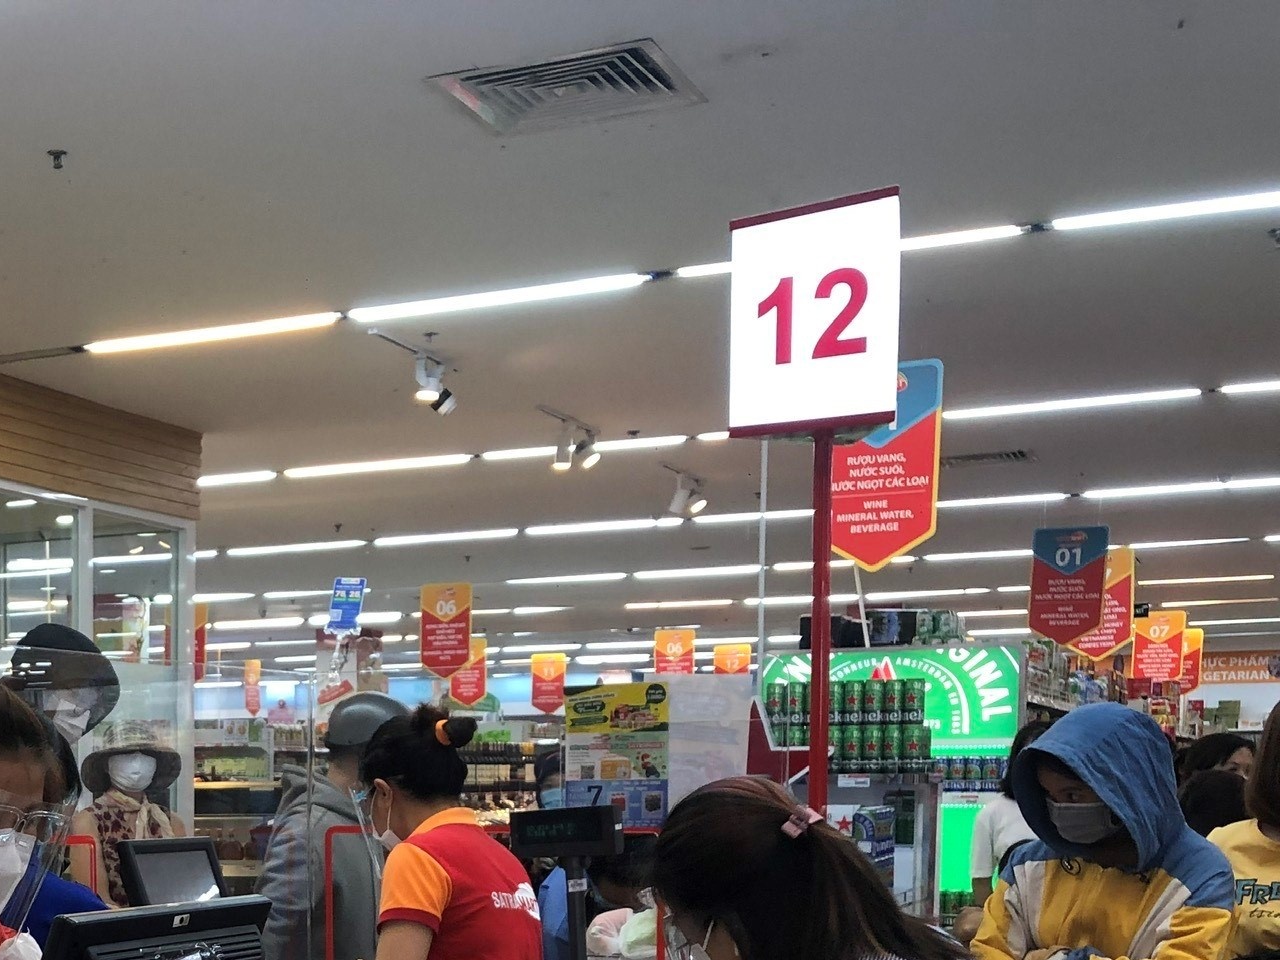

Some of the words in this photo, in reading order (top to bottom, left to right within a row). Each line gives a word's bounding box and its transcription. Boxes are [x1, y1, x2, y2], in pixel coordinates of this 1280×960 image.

[757, 267, 869, 365] 12
[857, 479, 884, 490] NGỌT
[885, 477, 906, 487] CÁC
[863, 500, 888, 509] WINE
[837, 512, 878, 522] MINERAL
[850, 522, 899, 534] BEVERAGE
[1055, 548, 1082, 567] 01
[436, 600, 457, 616] 06
[1149, 625, 1170, 638] 07
[666, 642, 683, 654] 06
[1203, 669, 1270, 681] GETARIAN
[936, 648, 1013, 722] GINAL
